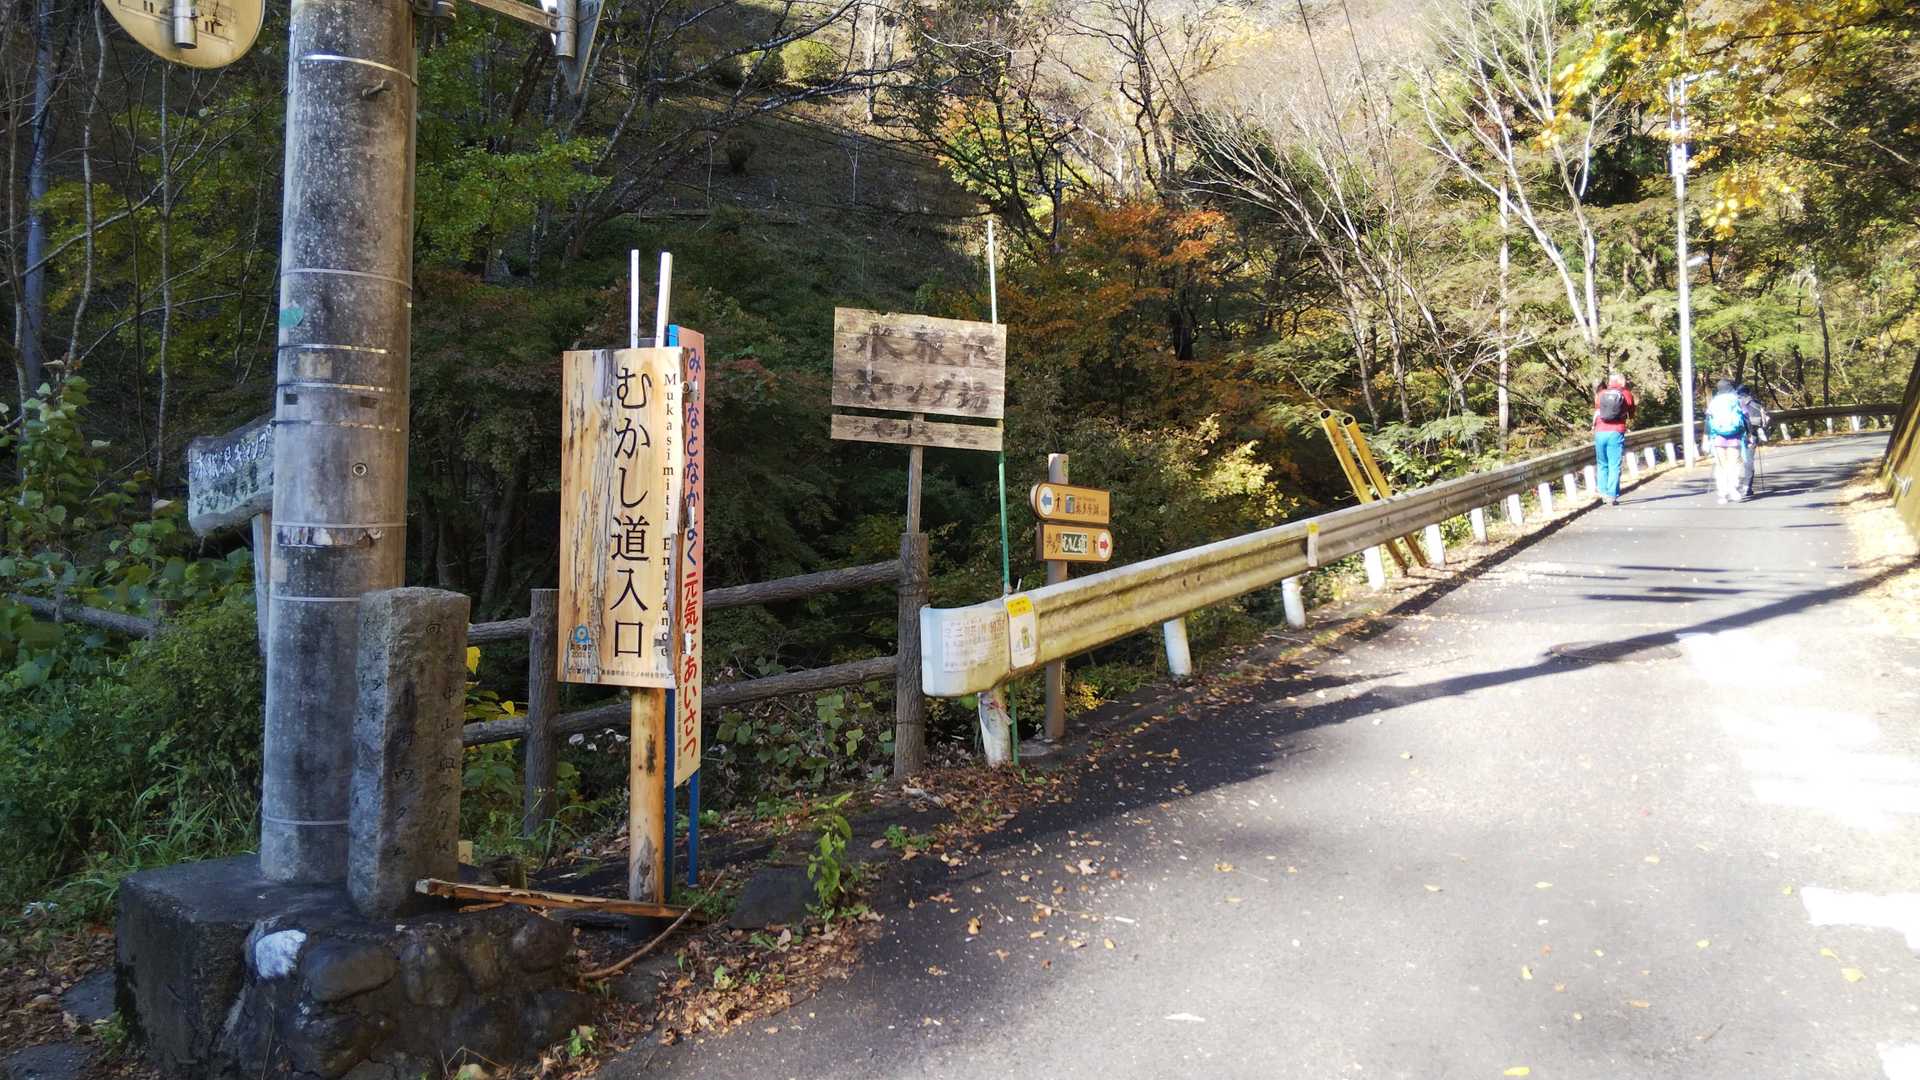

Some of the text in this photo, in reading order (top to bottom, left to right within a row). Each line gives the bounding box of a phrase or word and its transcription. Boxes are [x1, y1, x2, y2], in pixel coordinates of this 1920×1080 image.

[610, 367, 652, 658] むかし道入口
[661, 373, 677, 657] Mukasimiti Entrance
